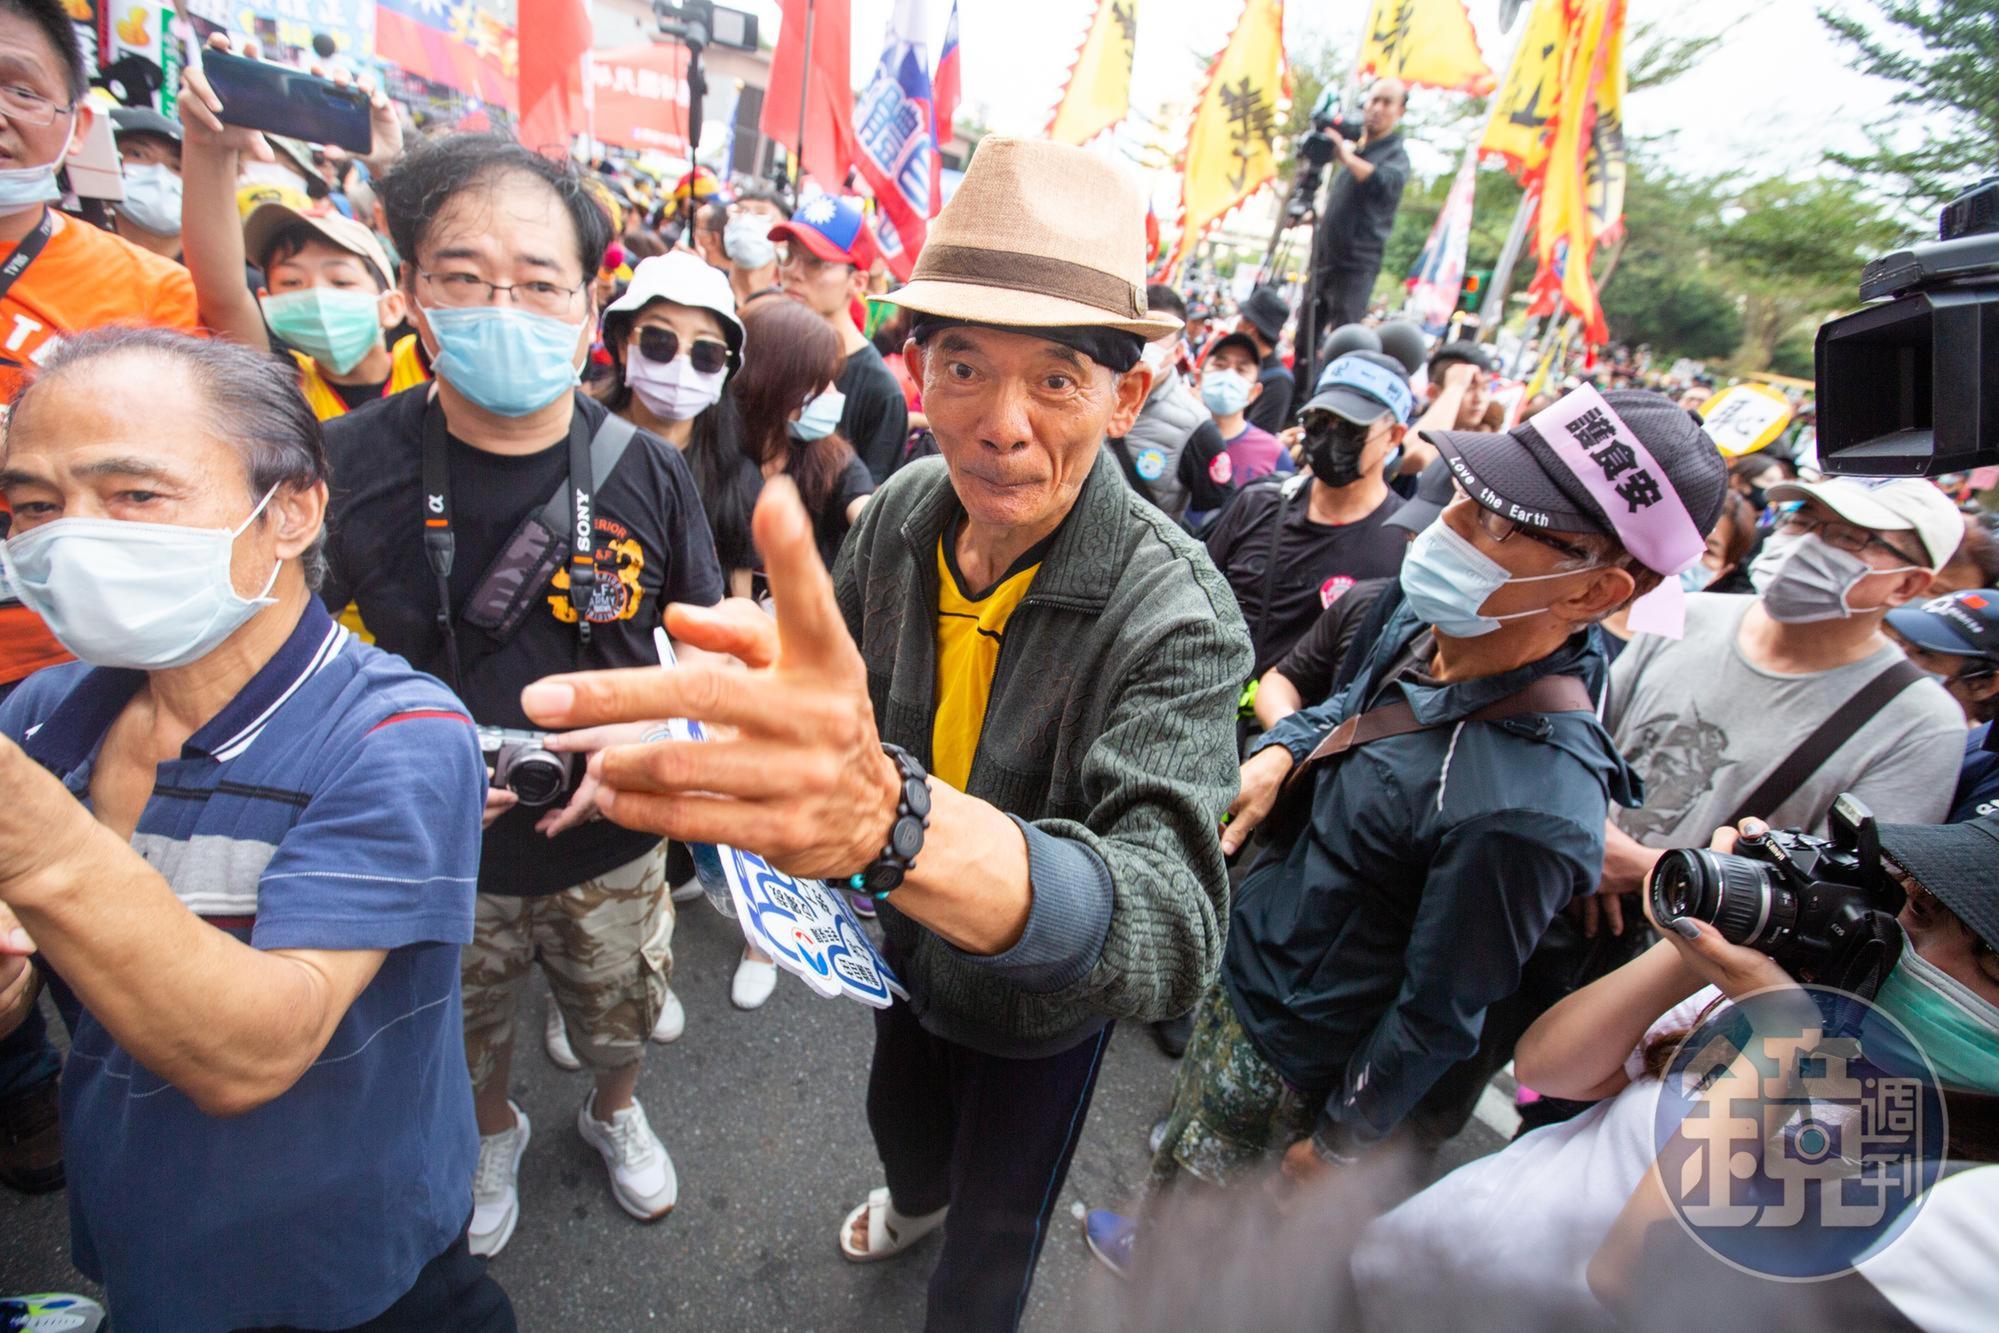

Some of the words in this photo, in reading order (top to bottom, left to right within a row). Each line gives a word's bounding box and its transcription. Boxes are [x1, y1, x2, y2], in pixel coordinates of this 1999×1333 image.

[1449, 456, 1475, 486] Love
[1480, 487, 1503, 509] the
[1508, 504, 1549, 528] Earth
[1565, 406, 1664, 513] 護食安
[576, 487, 591, 552] SONY
[1765, 838, 1786, 861] Canon
